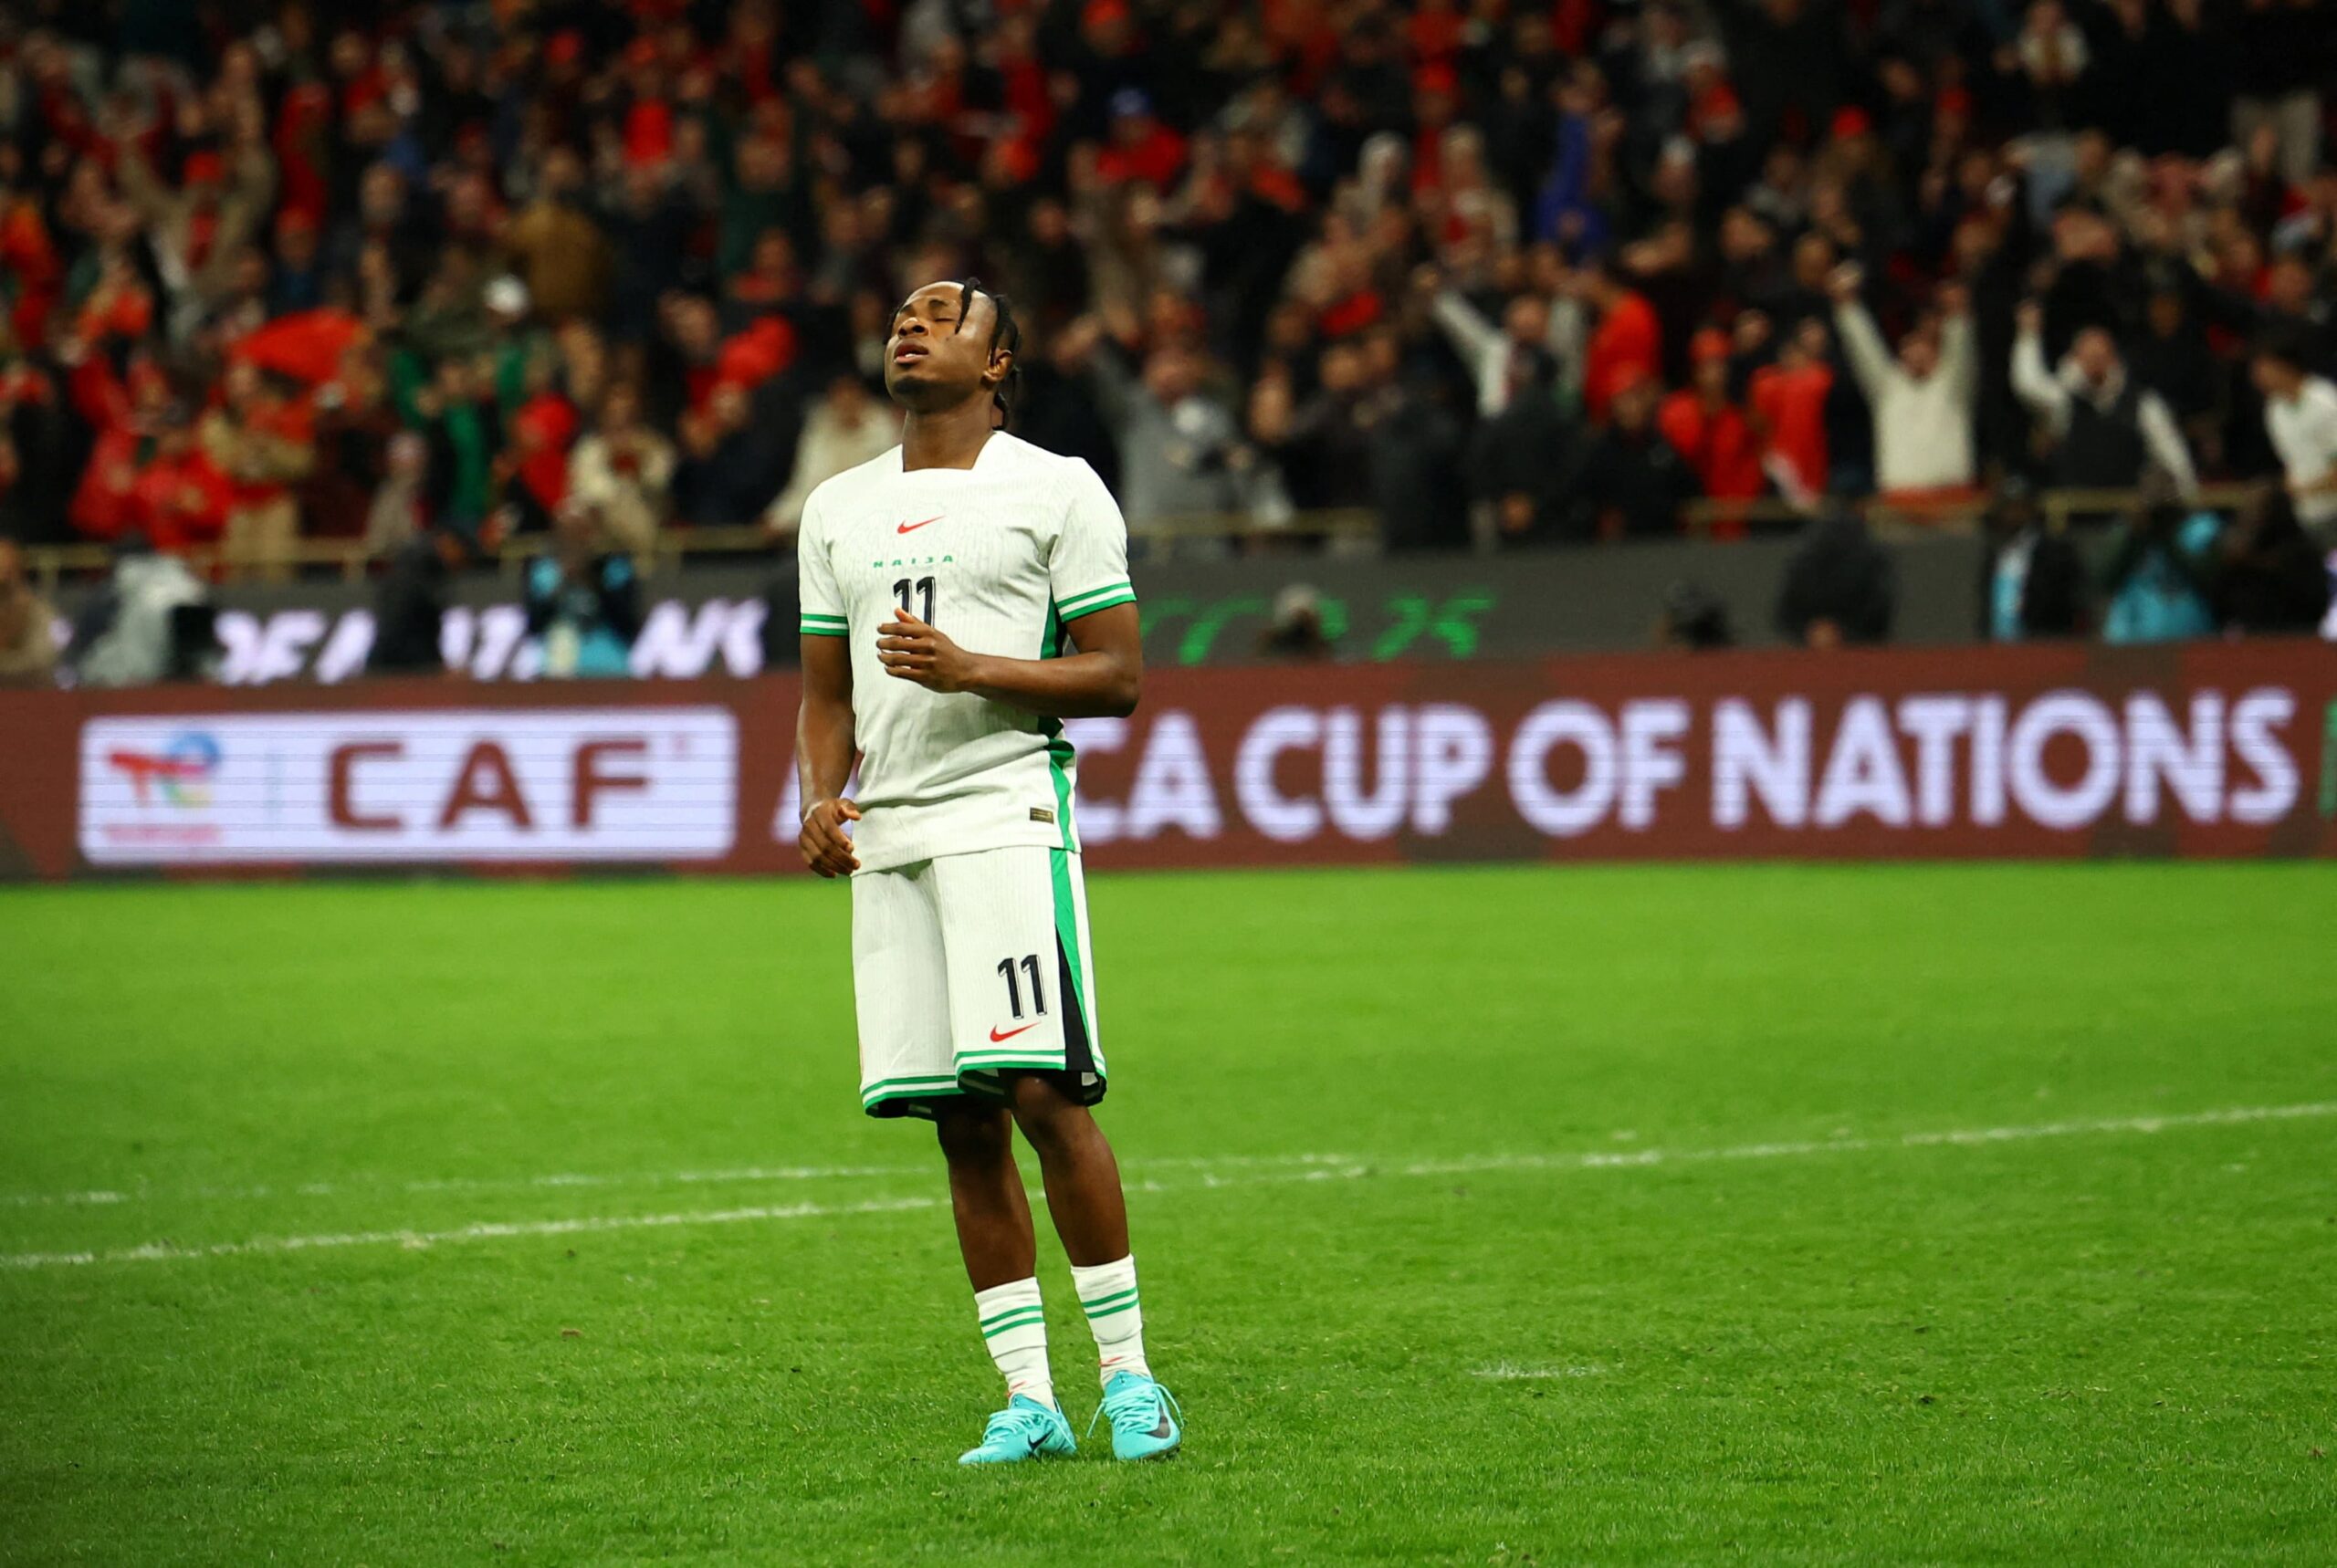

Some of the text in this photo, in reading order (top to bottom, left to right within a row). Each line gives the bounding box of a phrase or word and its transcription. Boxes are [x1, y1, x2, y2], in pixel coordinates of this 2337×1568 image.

[873, 555, 953, 569] NAIJA
[893, 576, 936, 628] 11
[327, 739, 649, 832] CAF
[1233, 705, 1493, 841] CUP
[1509, 696, 1690, 837] OF
[1710, 687, 2300, 828] NATIONS
[998, 954, 1047, 1019] 11
